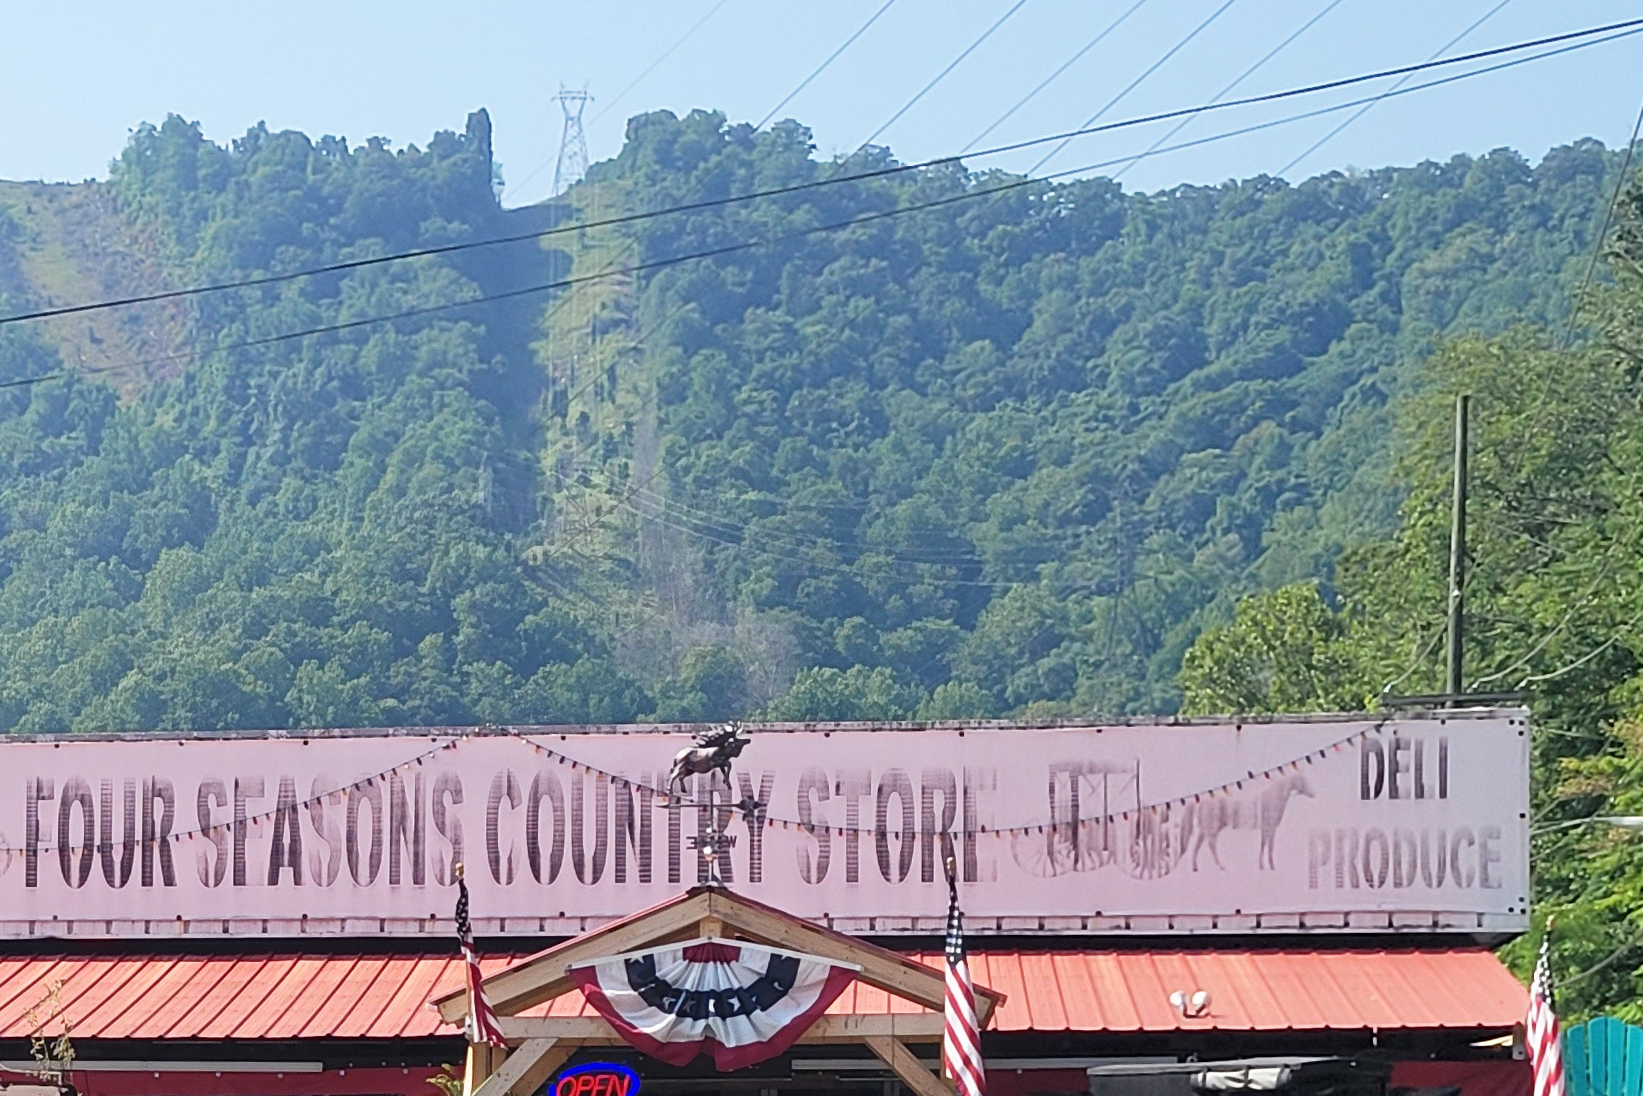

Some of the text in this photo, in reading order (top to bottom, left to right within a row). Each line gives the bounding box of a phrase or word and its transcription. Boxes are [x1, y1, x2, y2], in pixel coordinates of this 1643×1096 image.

[1360, 737, 1448, 800] DELI
[25, 766, 997, 889] FOUR SEASONS COUNTRY STORE
[1308, 826, 1503, 890] PRODUCE
